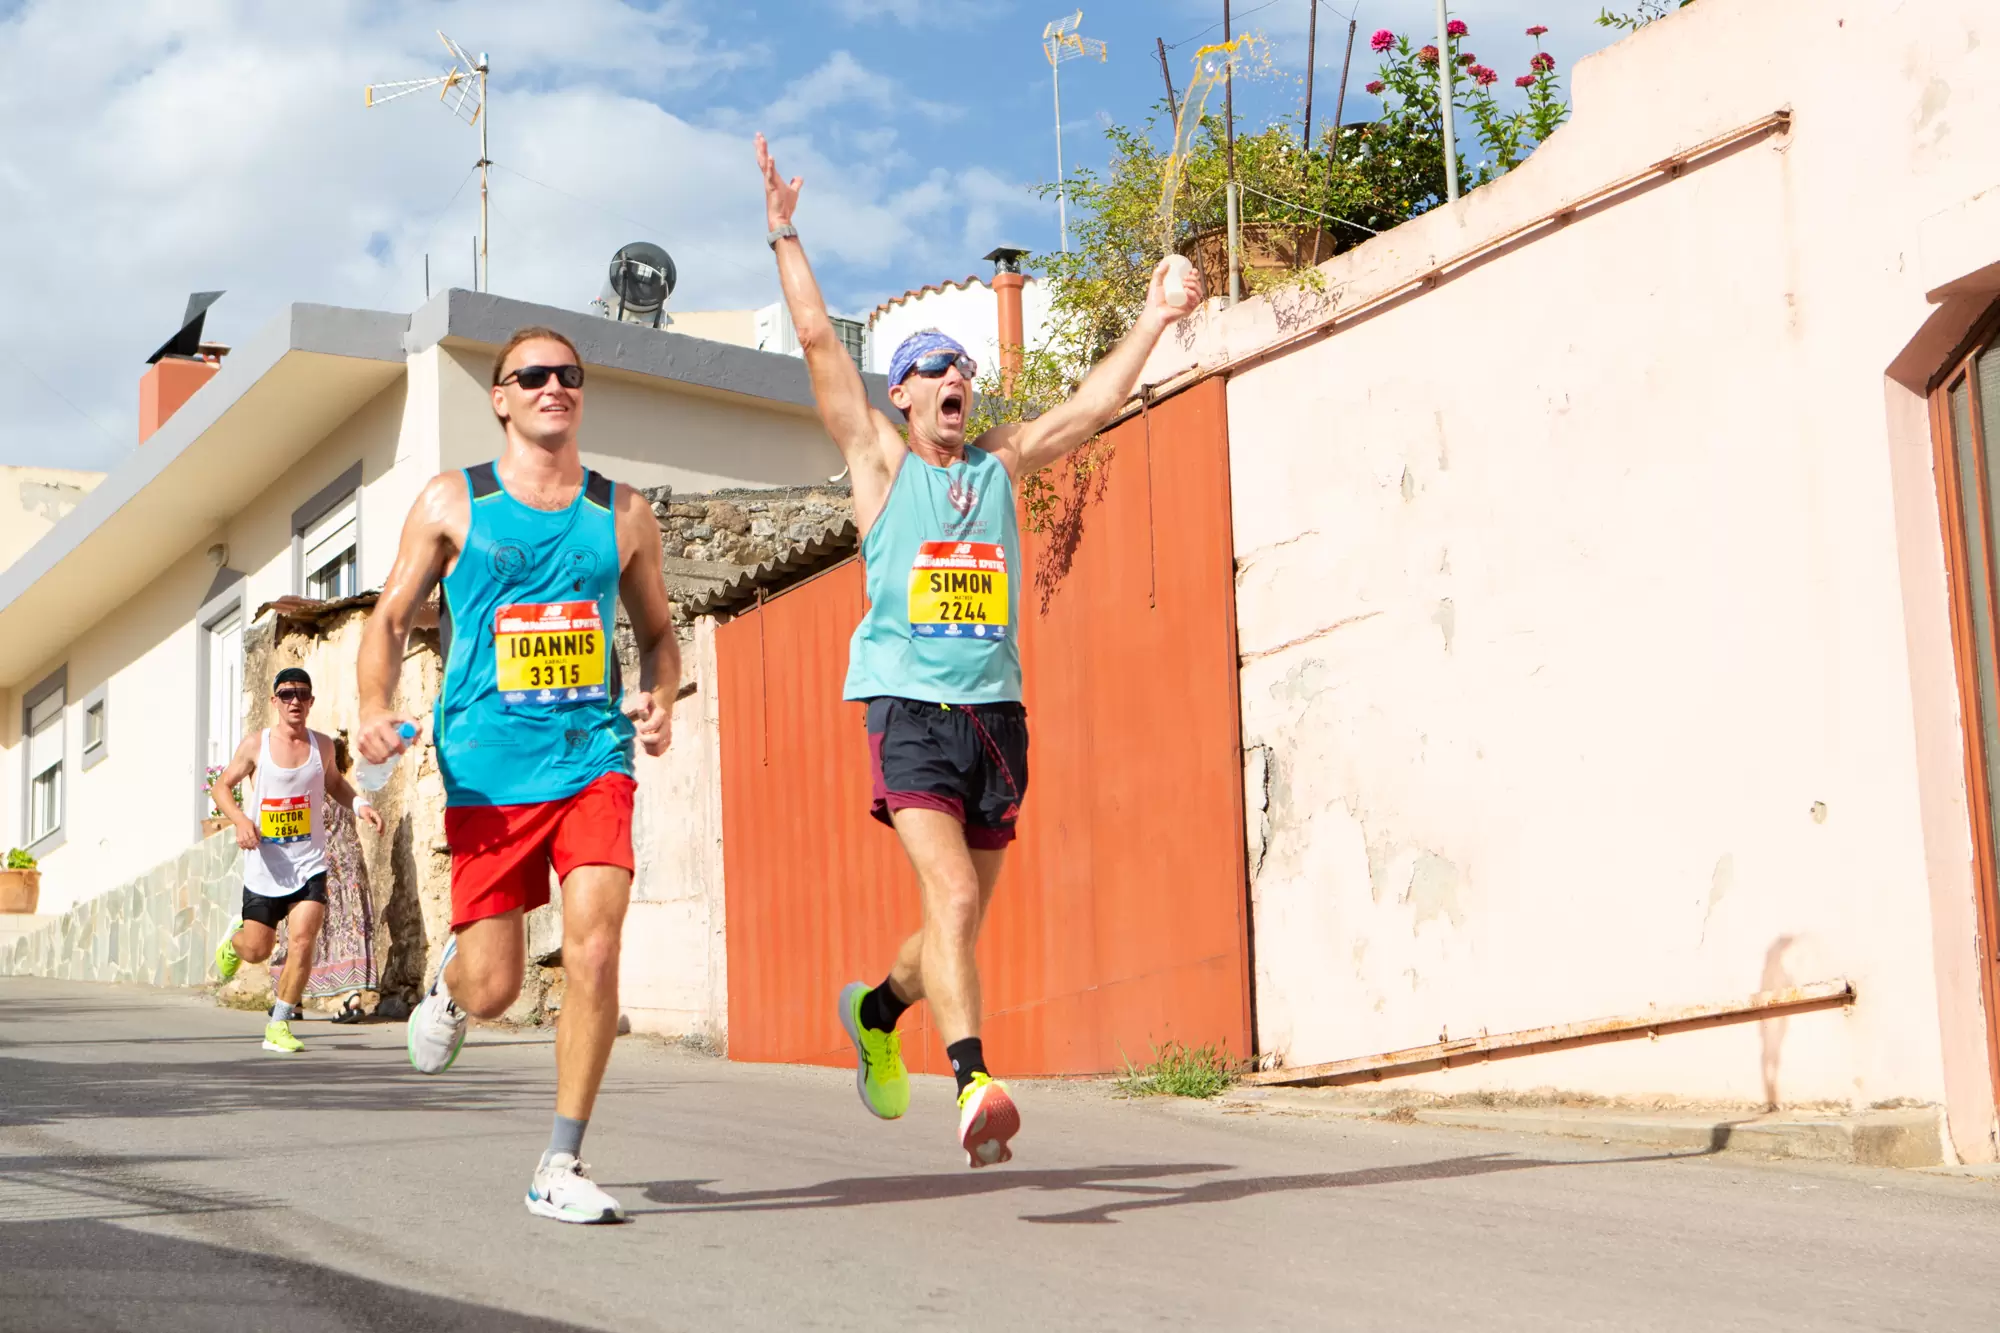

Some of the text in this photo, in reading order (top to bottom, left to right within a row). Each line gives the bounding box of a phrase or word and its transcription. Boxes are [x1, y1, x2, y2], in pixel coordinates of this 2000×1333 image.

[930, 572, 993, 595] SIMON
[939, 601, 987, 621] 2244
[511, 633, 596, 659] IOANNIS
[530, 664, 580, 687] 3315
[268, 810, 304, 823] VICTOR
[275, 825, 299, 837] 2854
